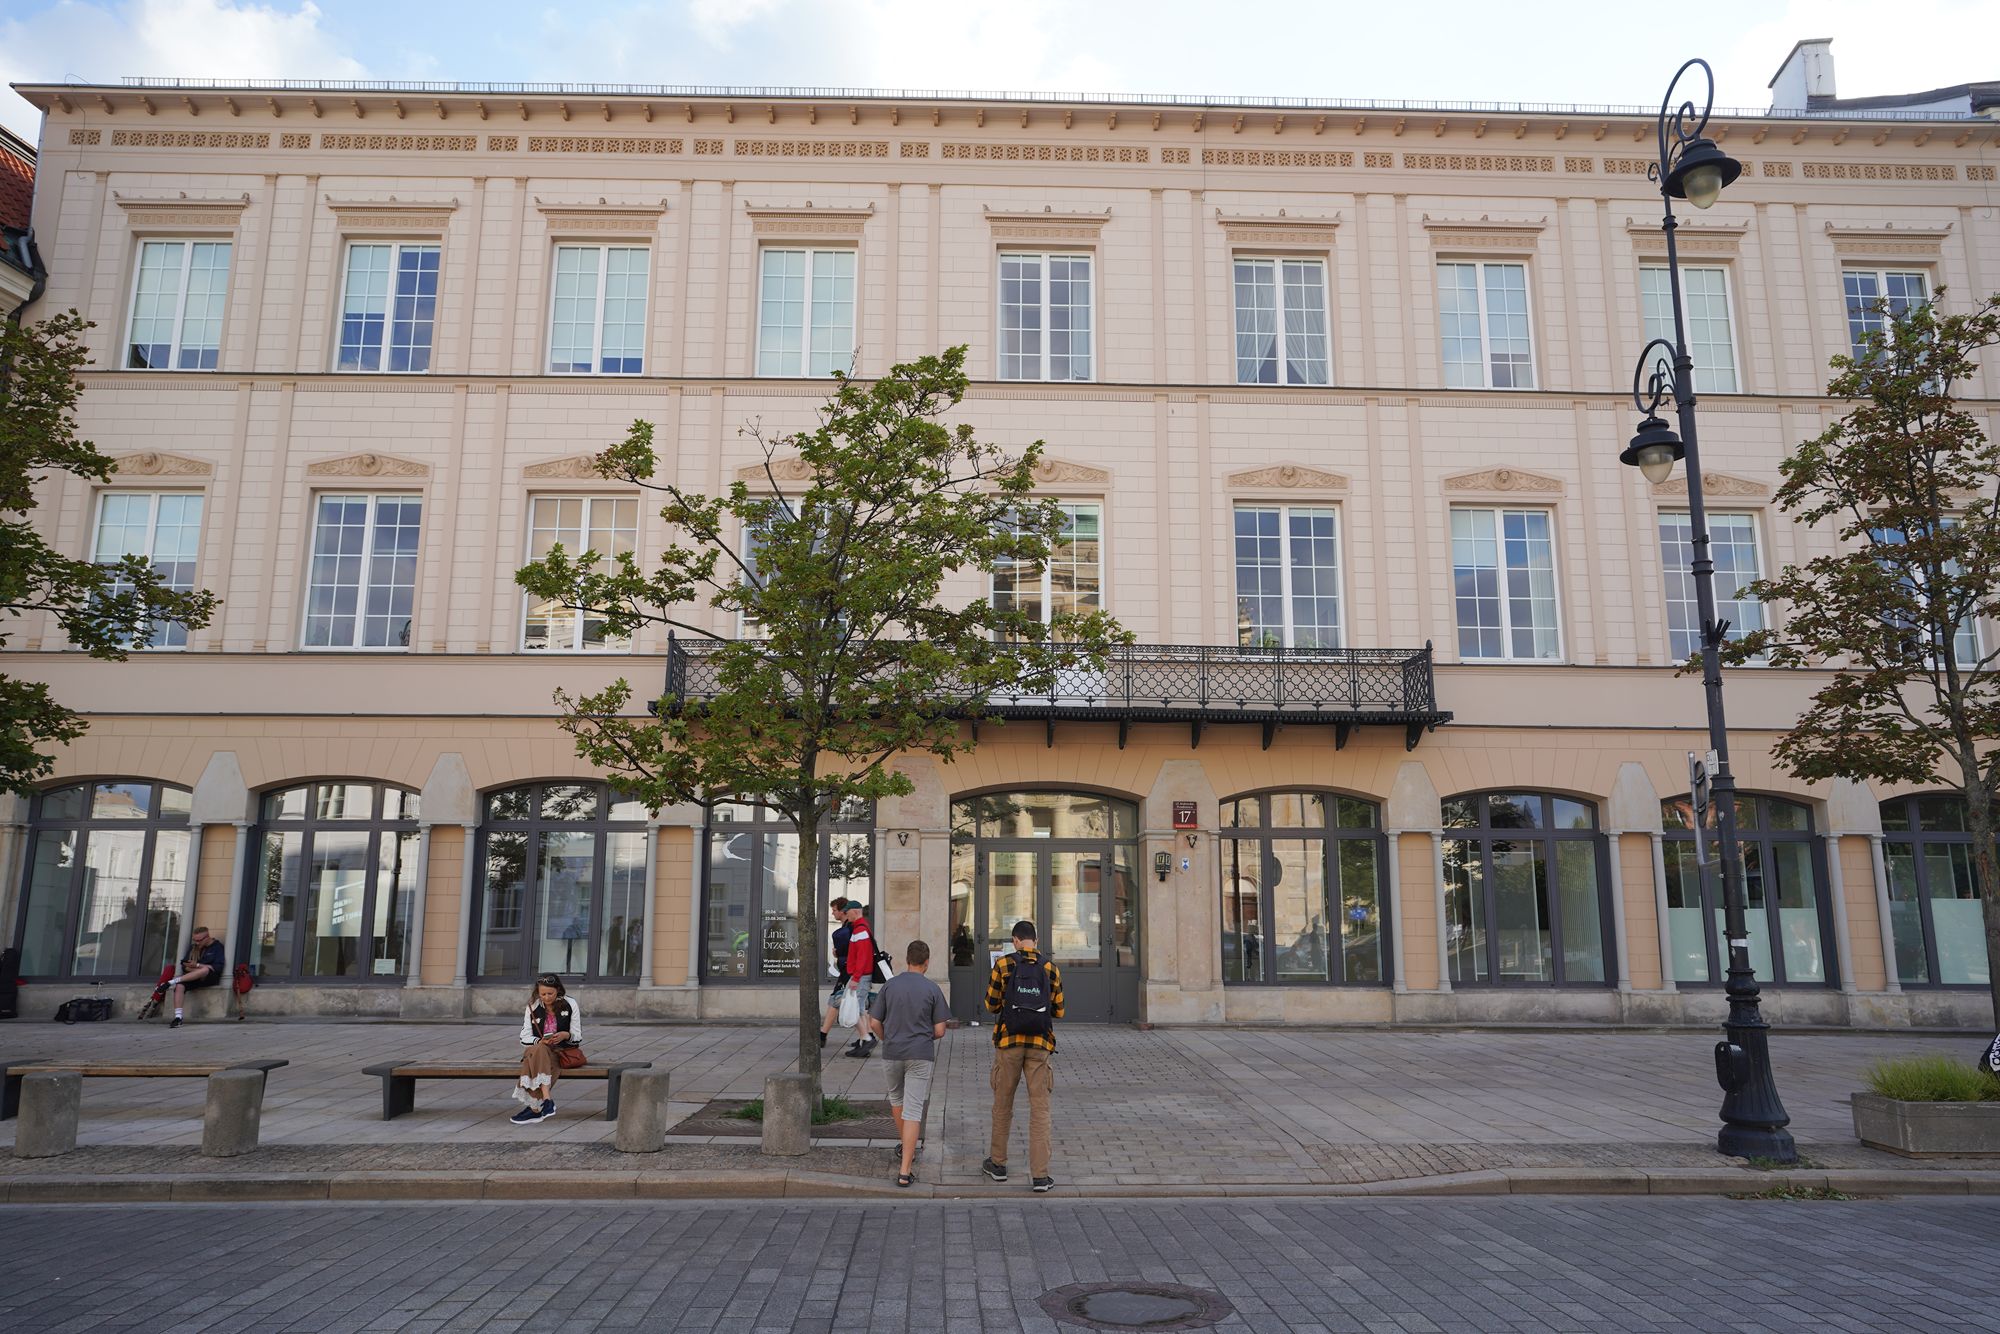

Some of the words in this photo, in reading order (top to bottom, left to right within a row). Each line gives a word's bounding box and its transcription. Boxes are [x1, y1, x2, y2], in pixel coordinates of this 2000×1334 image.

[1178, 810, 1191, 823] 17
[763, 928, 788, 939] Linia
[763, 938, 799, 952] brzego
